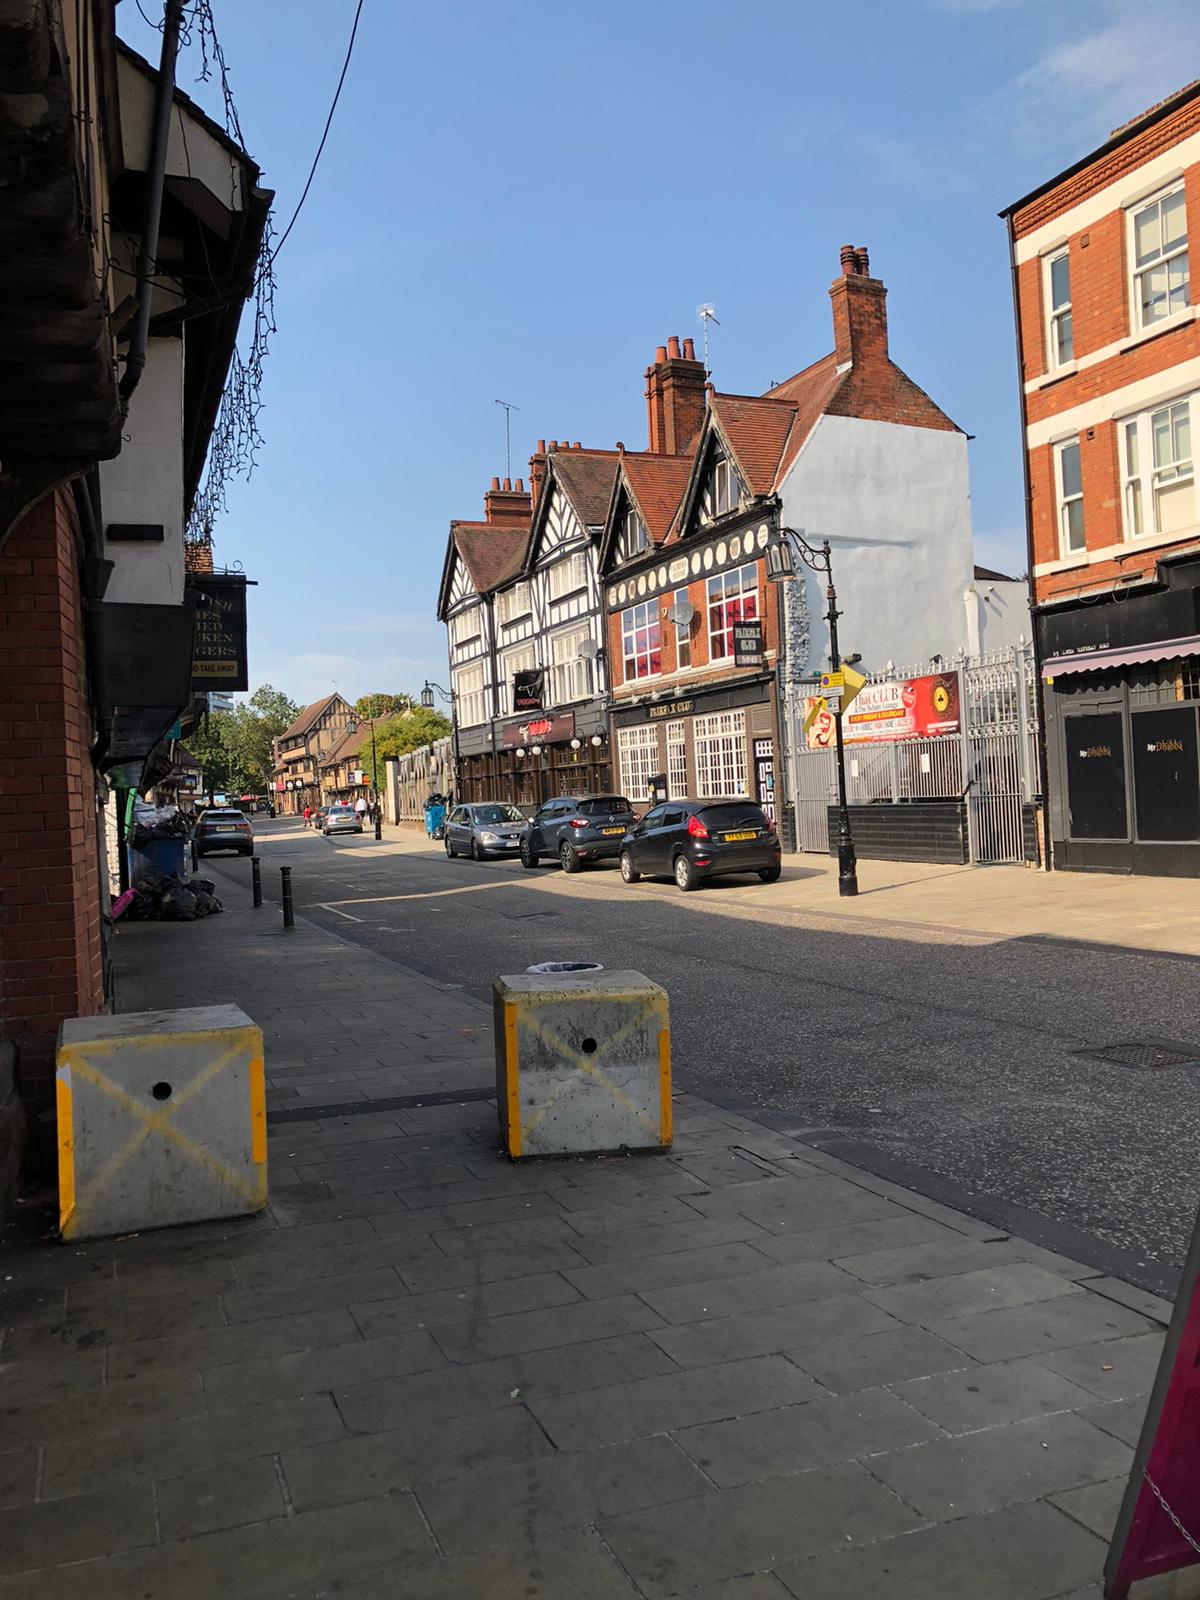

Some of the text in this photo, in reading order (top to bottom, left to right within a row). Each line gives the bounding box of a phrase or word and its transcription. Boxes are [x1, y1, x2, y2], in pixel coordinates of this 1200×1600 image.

[196, 610, 221, 620] IES
[196, 622, 223, 631] IED
[200, 633, 233, 642] KEN
[195, 646, 237, 656] GERS
[200, 664, 215, 673] TAKE
[216, 664, 235, 673] AWAY
[872, 687, 899, 704] CLUB
